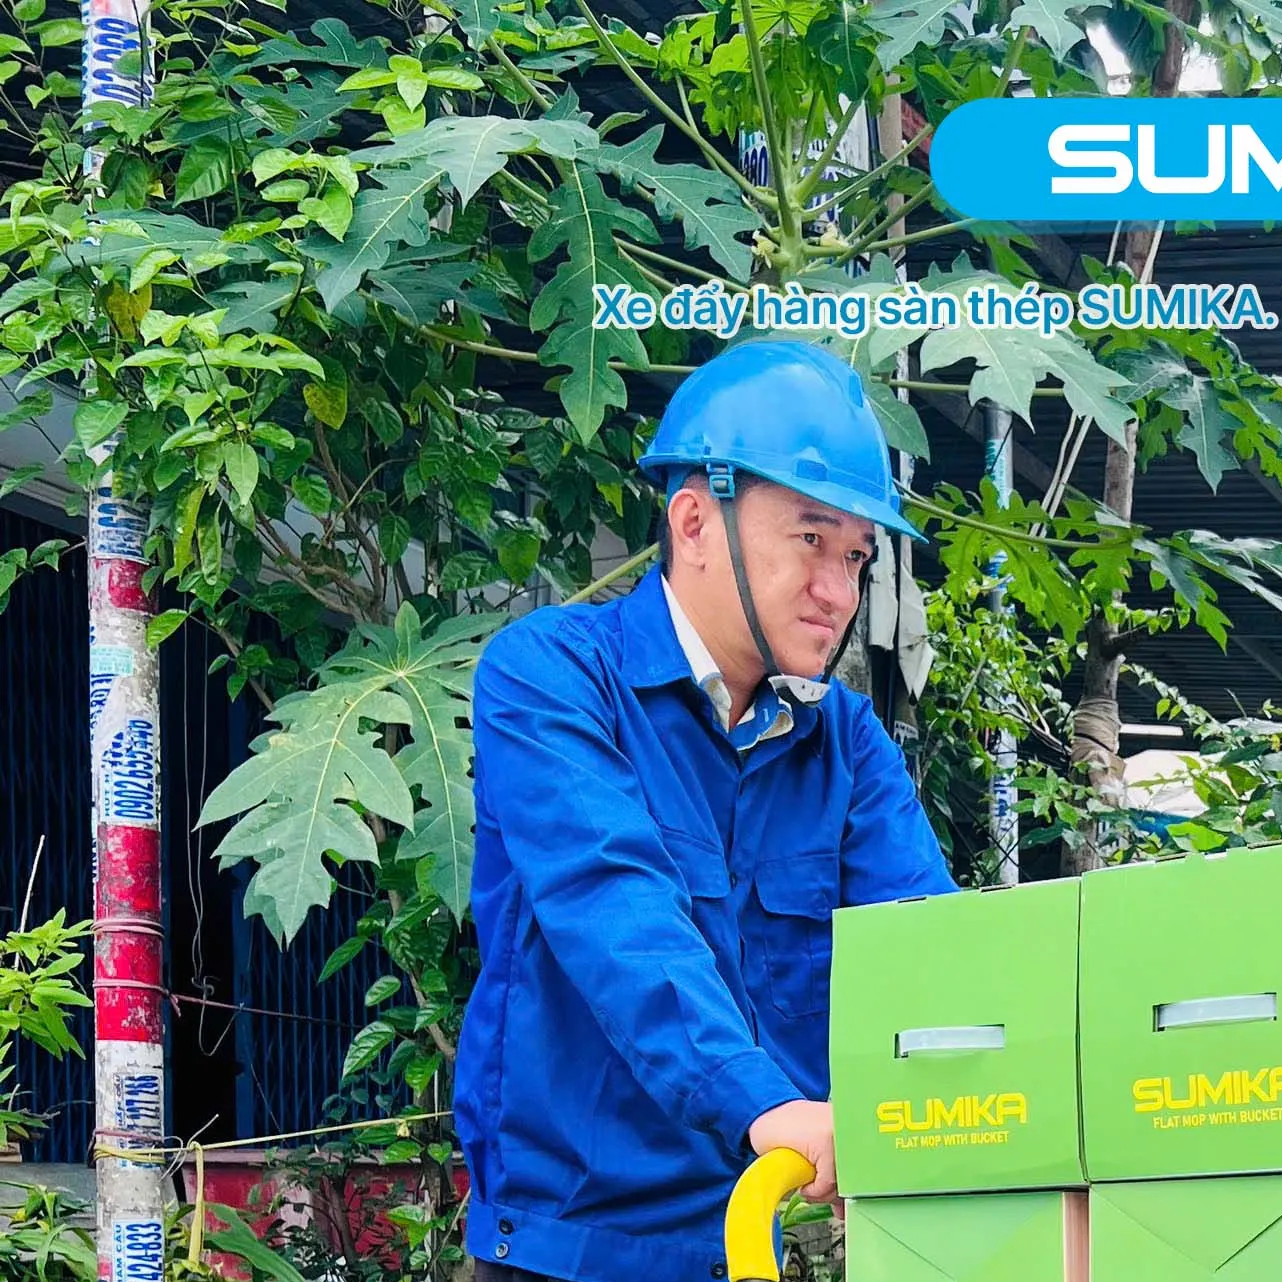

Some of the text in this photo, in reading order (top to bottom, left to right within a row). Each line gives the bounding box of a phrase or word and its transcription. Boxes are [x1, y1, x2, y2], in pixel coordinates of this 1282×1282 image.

[876, 1092, 1028, 1134] SUMIKA
[1153, 1114, 1180, 1129] FLAT
[1183, 1113, 1206, 1127] MOP
[1208, 1111, 1237, 1125] WITH
[896, 1131, 1009, 1148] FLAT MOP WITH BUCKET
